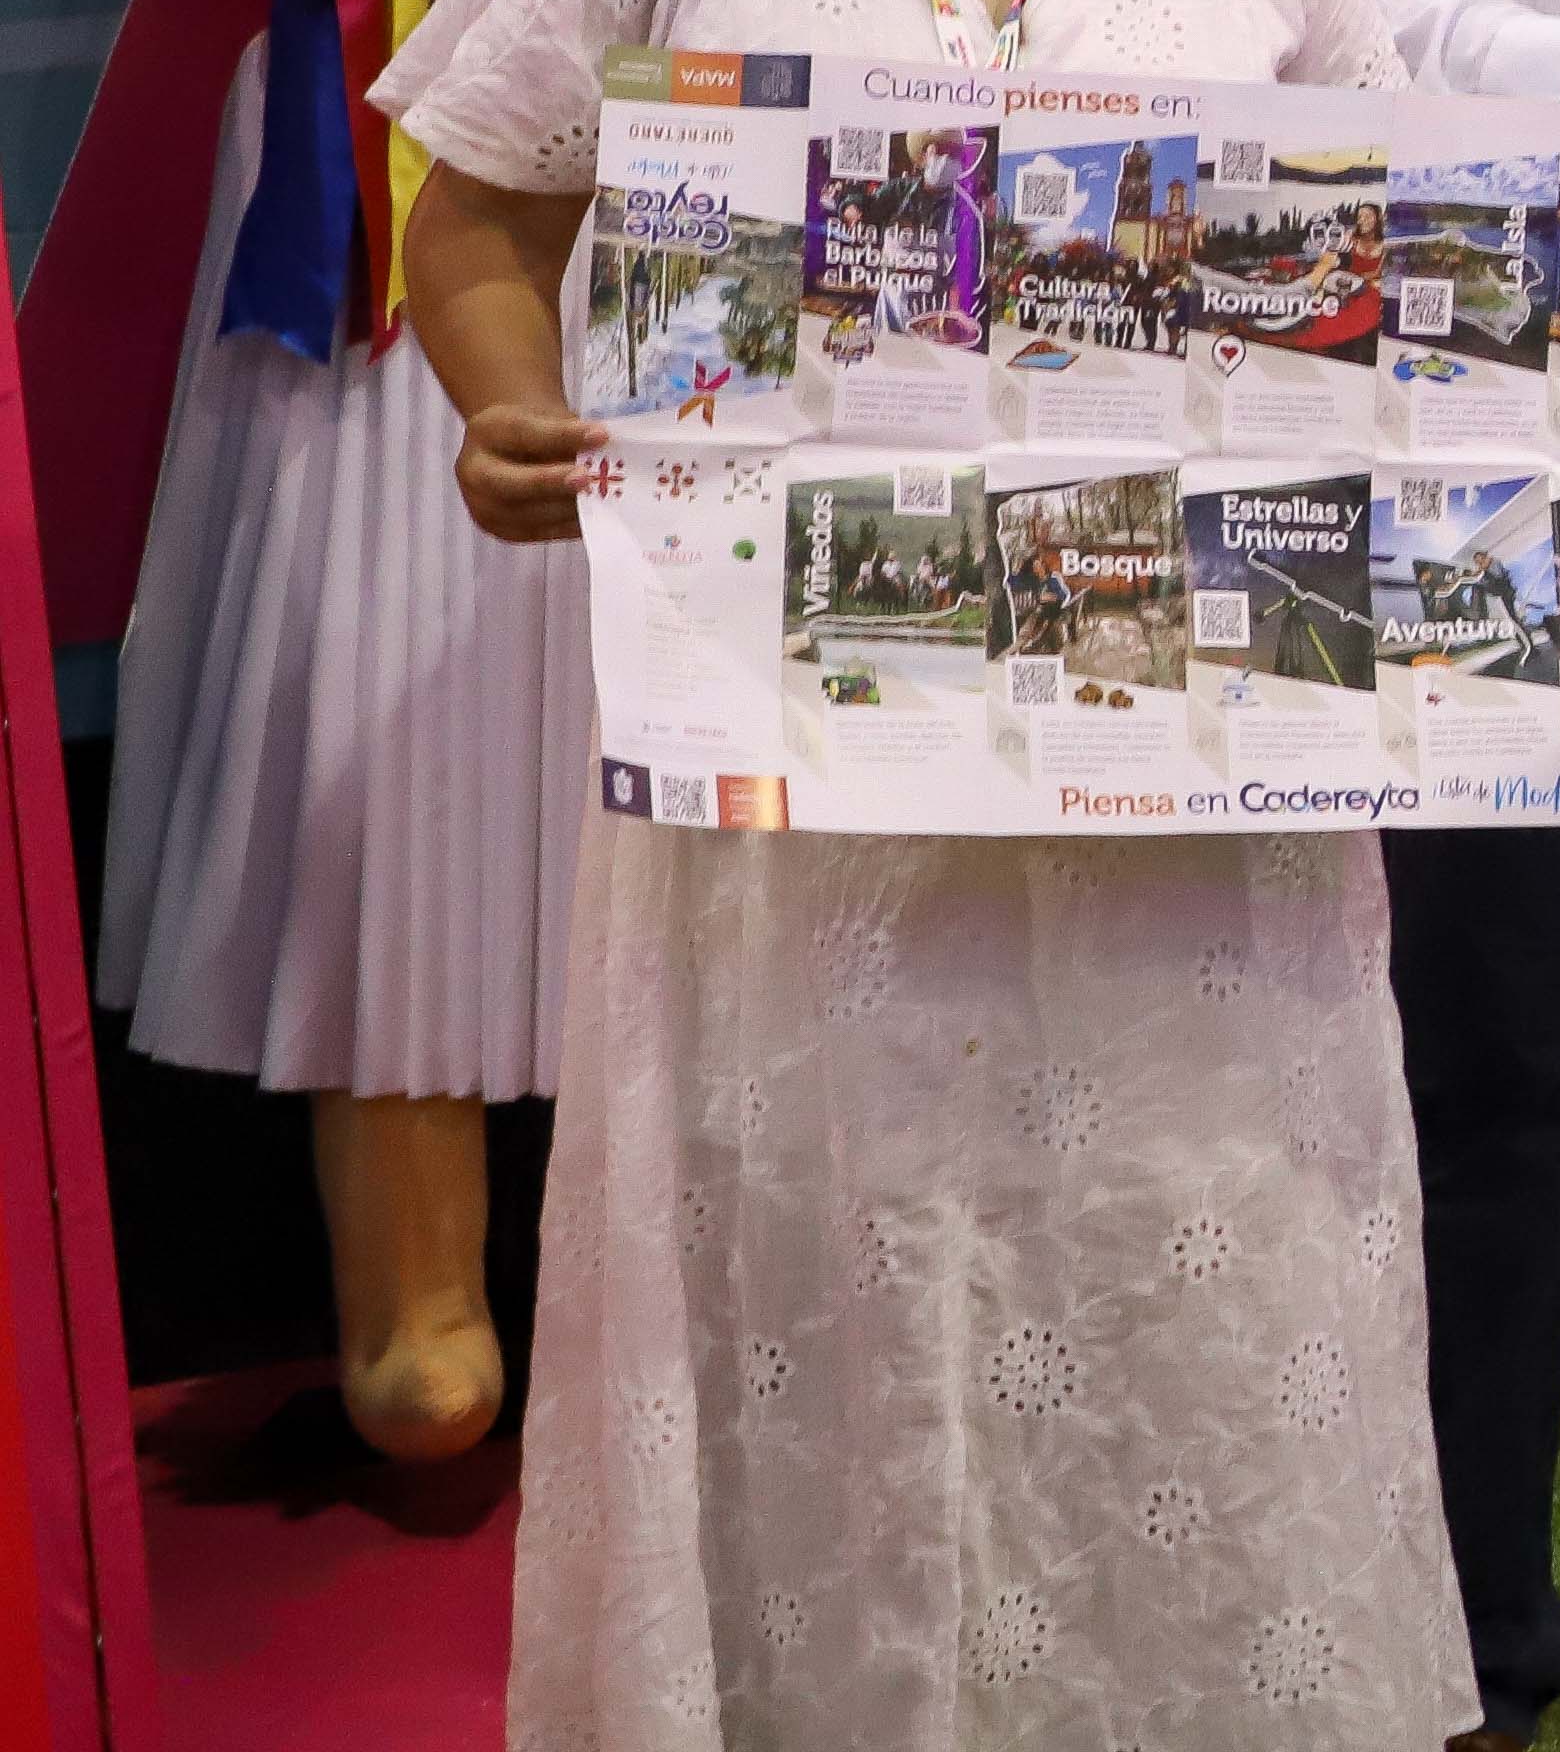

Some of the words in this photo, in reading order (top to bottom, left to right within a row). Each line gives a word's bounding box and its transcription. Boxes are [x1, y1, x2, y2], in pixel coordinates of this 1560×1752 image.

[681, 68, 737, 88] MAPA
[864, 68, 995, 109] Cuando
[1003, 80, 1140, 117] pienses
[626, 181, 730, 217] reyta
[625, 215, 731, 252] Cade
[885, 222, 914, 246] de
[920, 221, 938, 247] la
[826, 240, 938, 270] Barbacoa
[943, 253, 957, 276] y
[823, 264, 843, 287] el
[851, 264, 934, 295] Pulque
[1019, 274, 1111, 300] Cultura
[1113, 281, 1132, 305] y
[1019, 297, 1136, 326] Tradición
[1202, 287, 1341, 320] Romance
[1222, 494, 1339, 526] Estrellas
[1345, 503, 1363, 532] y
[1222, 520, 1349, 552] Universo
[802, 491, 834, 617] Viñedos
[1060, 549, 1173, 581] Bosque
[1381, 615, 1519, 643] Aventura
[1059, 786, 1178, 816] Piensa
[1187, 792, 1230, 815] en
[1240, 782, 1420, 820] Cadereyta
